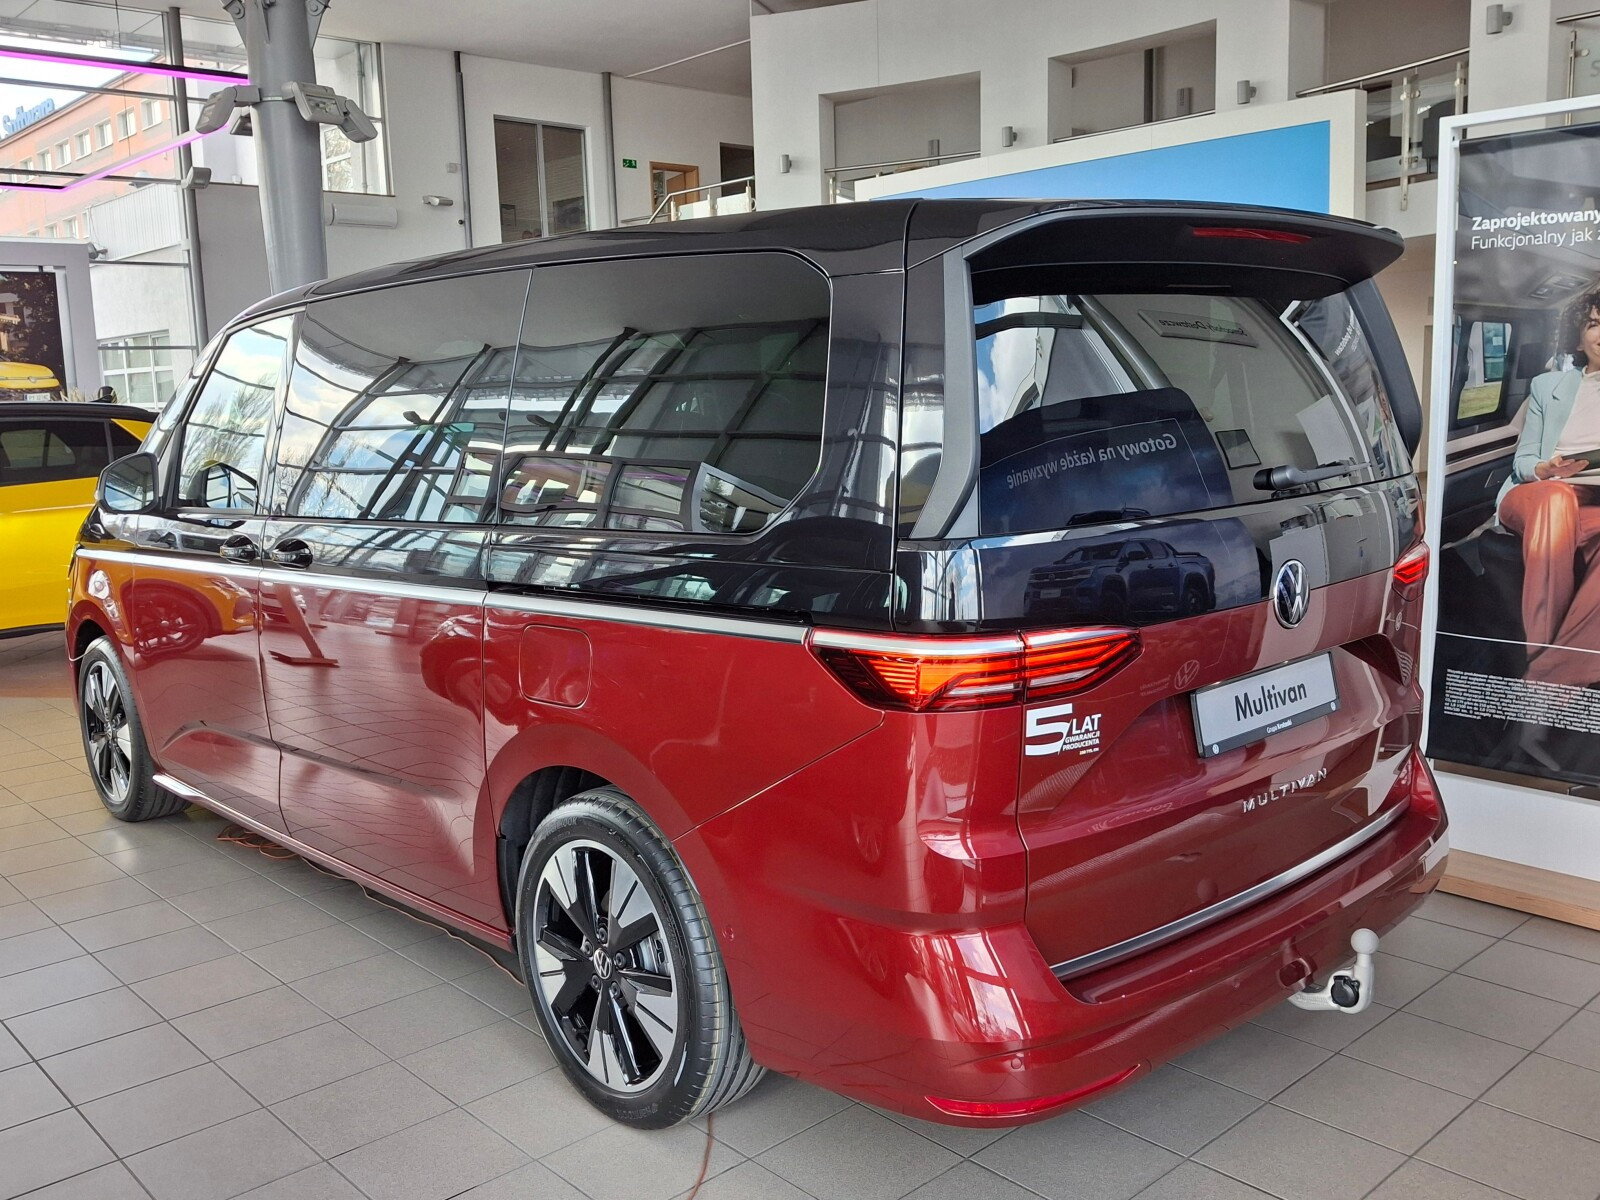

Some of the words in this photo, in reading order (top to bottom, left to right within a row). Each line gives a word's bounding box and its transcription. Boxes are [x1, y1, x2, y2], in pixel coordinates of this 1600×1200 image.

[1471, 209, 1600, 232] Zaprojektowany
[1471, 230, 1567, 250] Funkcjonalny
[1569, 227, 1593, 246] jak
[1234, 683, 1308, 722] Multivan
[1025, 703, 1072, 755] 5
[1071, 713, 1102, 735] LAT
[1064, 730, 1100, 744] GWARANCJI
[1062, 738, 1100, 752] PRODUCENTA
[1243, 767, 1327, 813] MULTIVAN
